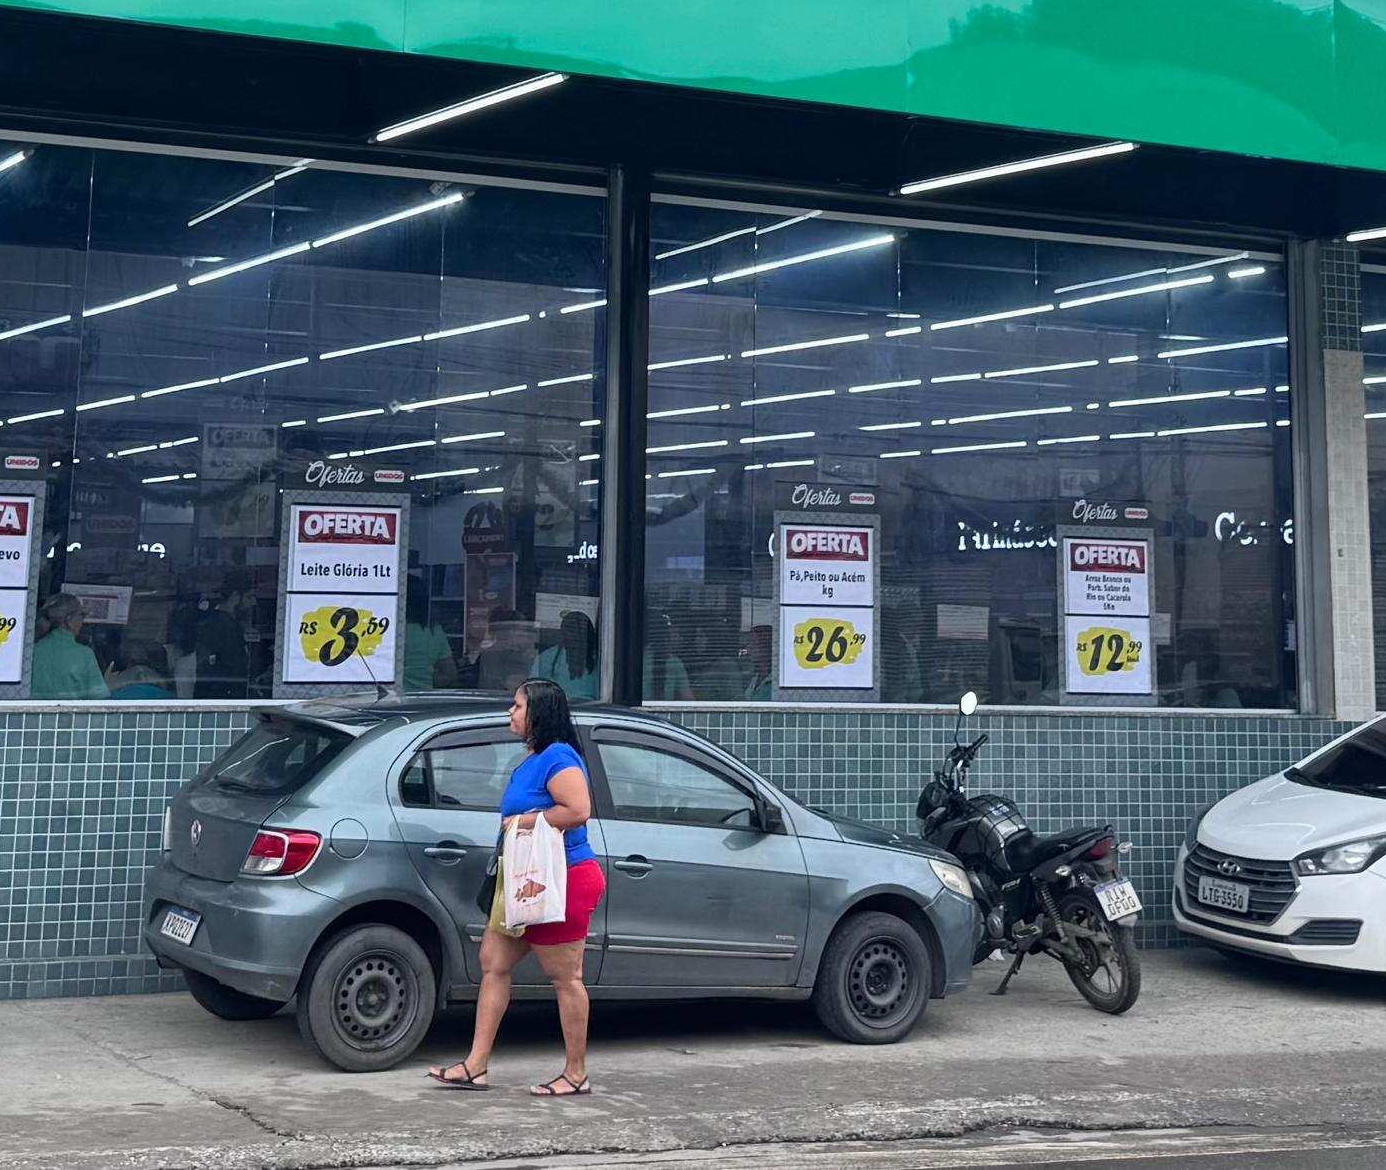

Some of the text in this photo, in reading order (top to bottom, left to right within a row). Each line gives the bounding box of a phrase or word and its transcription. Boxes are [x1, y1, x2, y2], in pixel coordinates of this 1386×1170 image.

[305, 460, 365, 488] Ofertas
[791, 483, 842, 509] Ofertas
[1073, 499, 1118, 523] Ofertas
[304, 514, 390, 538] OFERTA
[791, 533, 864, 555] OFERTA
[1075, 546, 1141, 568] OFERTA
[301, 563, 392, 578] Leite Glória 1Lt
[828, 574, 840, 582] ou
[841, 572, 866, 583] Acém
[822, 584, 834, 598] kg
[299, 621, 318, 635] R$
